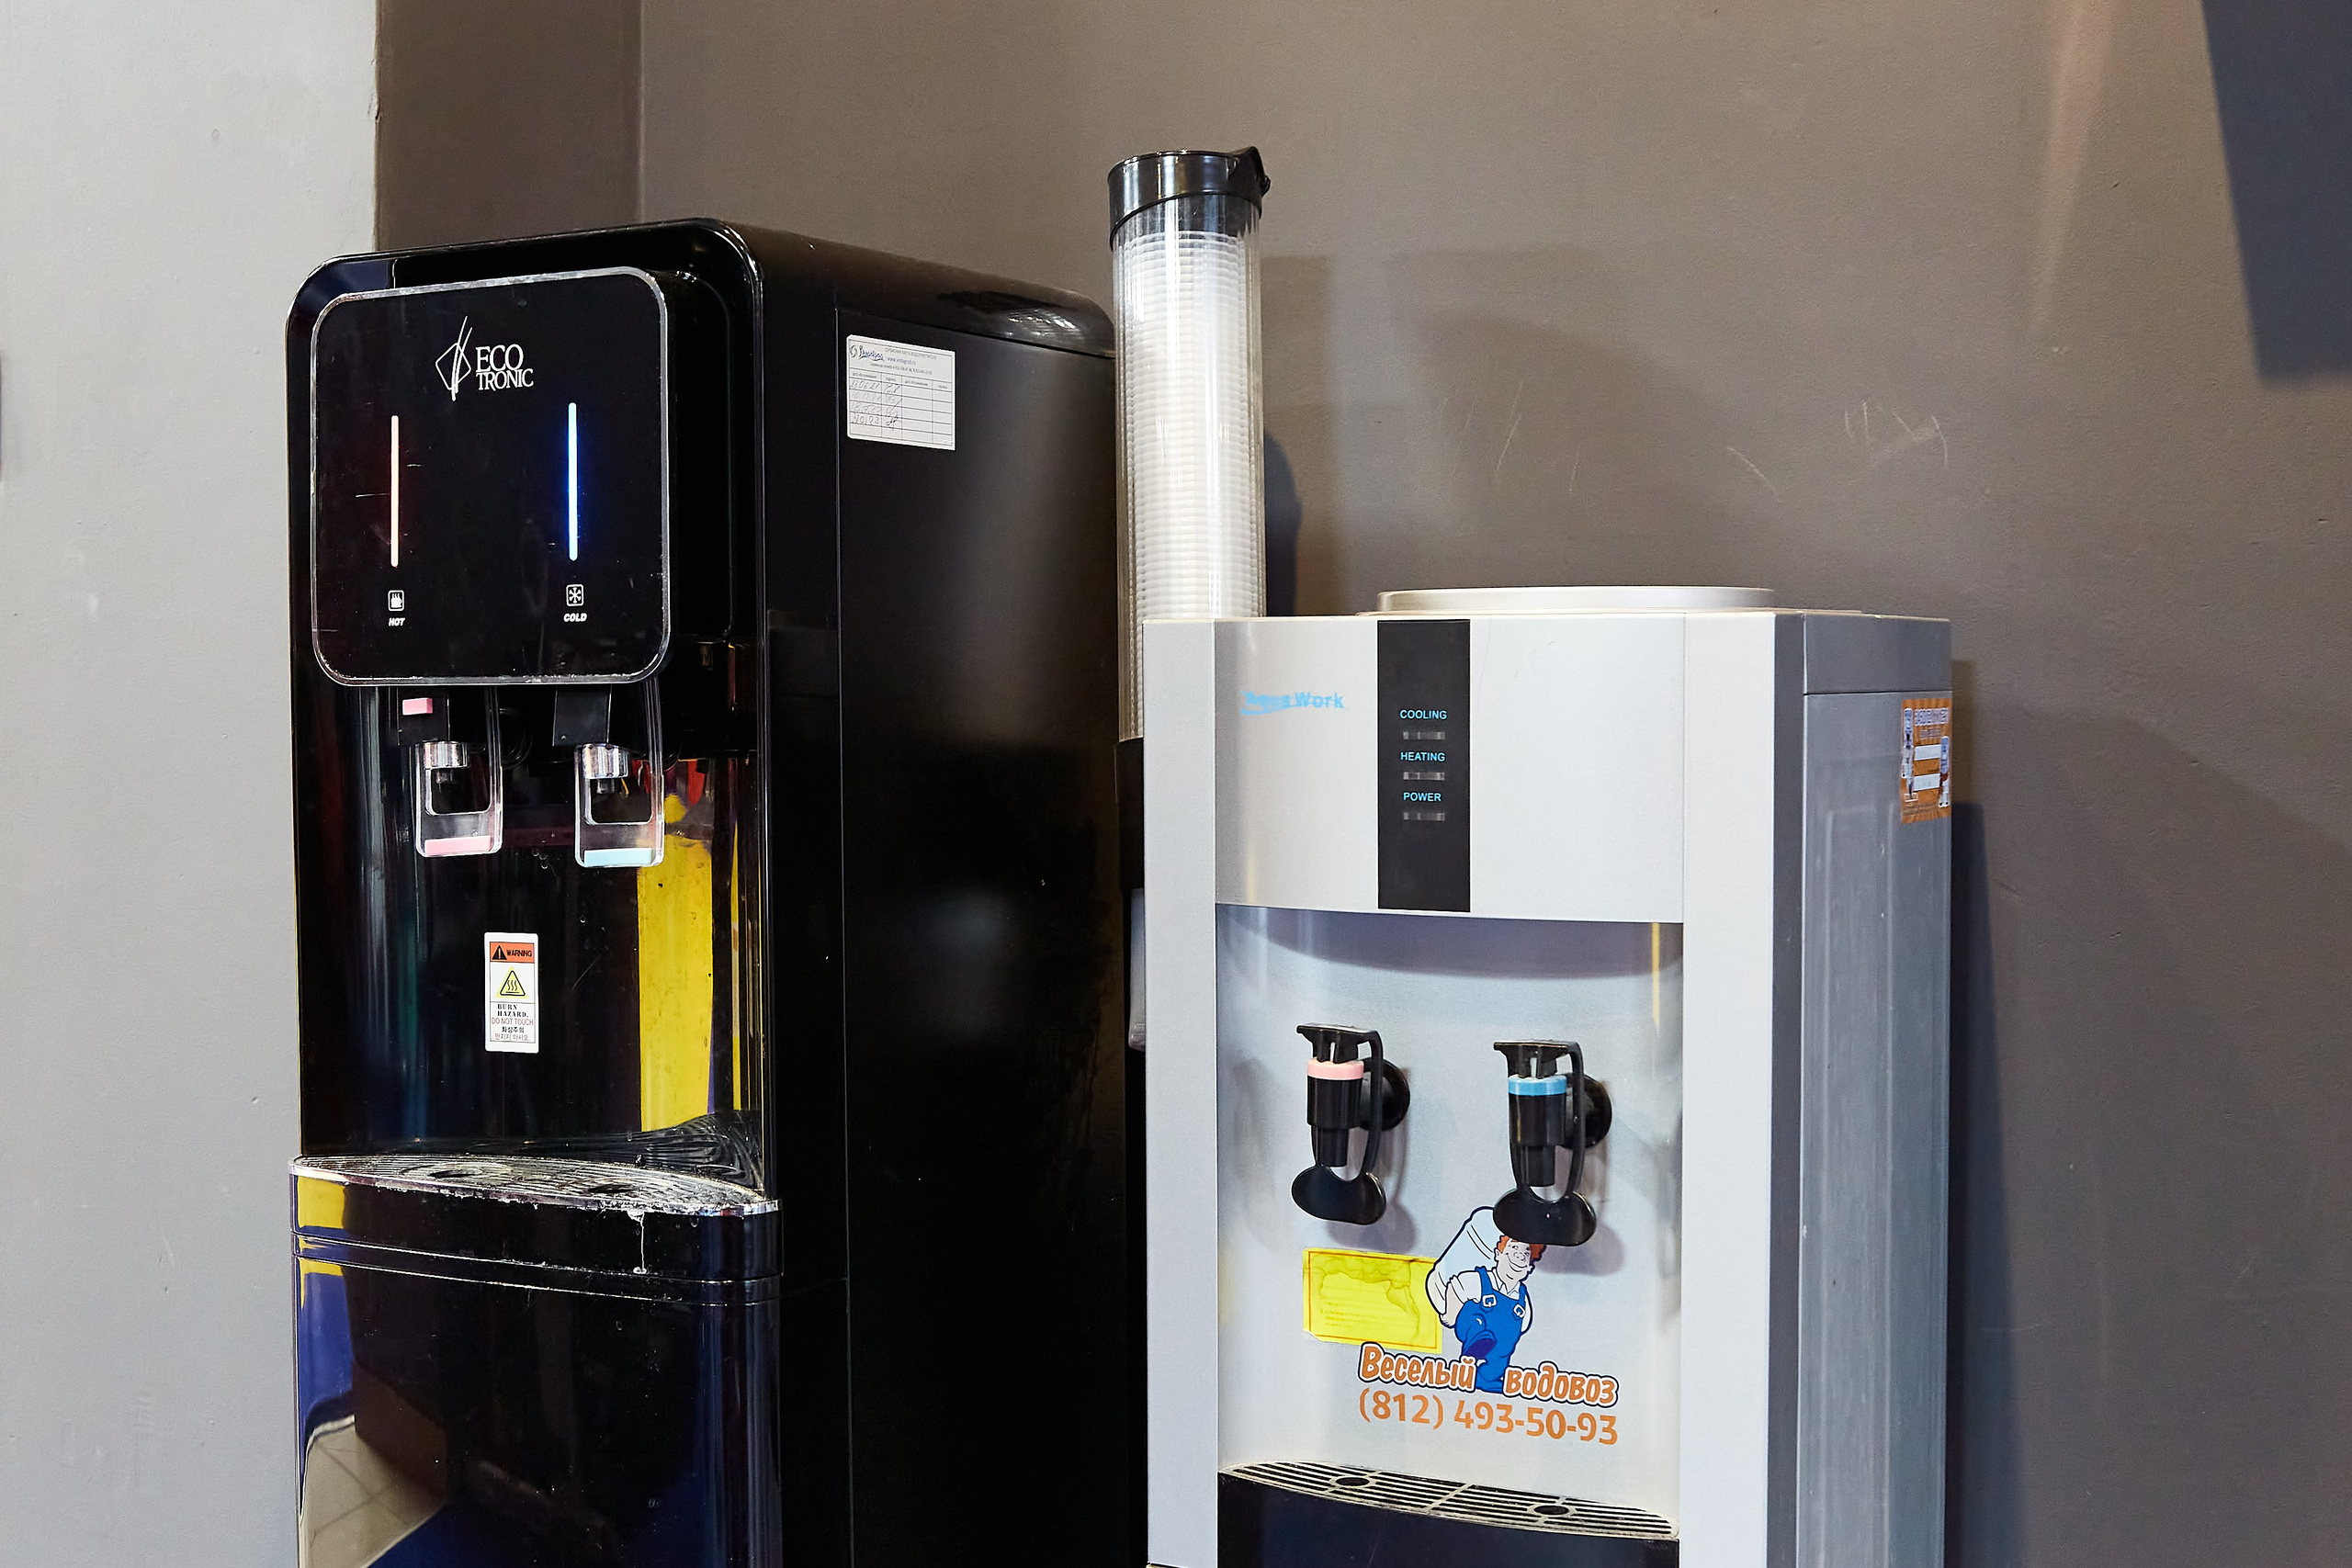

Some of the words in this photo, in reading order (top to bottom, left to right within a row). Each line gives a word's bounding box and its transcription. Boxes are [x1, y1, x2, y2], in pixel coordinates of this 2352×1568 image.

[475, 344, 524, 372] ECO
[475, 368, 534, 391] TRONIC
[389, 617, 406, 626] HOT
[563, 613, 588, 622] COLD
[1294, 692, 1344, 708] Work
[1399, 709, 1448, 719] COOLING
[1400, 751, 1446, 761] HEATING
[1403, 792, 1442, 802] POWER
[506, 949, 533, 957] WARNING
[501, 1017, 513, 1025] NOT
[514, 1018, 534, 1026] TOUCH
[1360, 1344, 1476, 1391] Веселый
[1504, 1363, 1617, 1405] водовоз
[1360, 1387, 1443, 1429] (812)
[1453, 1399, 1618, 1445] 493-50-93
